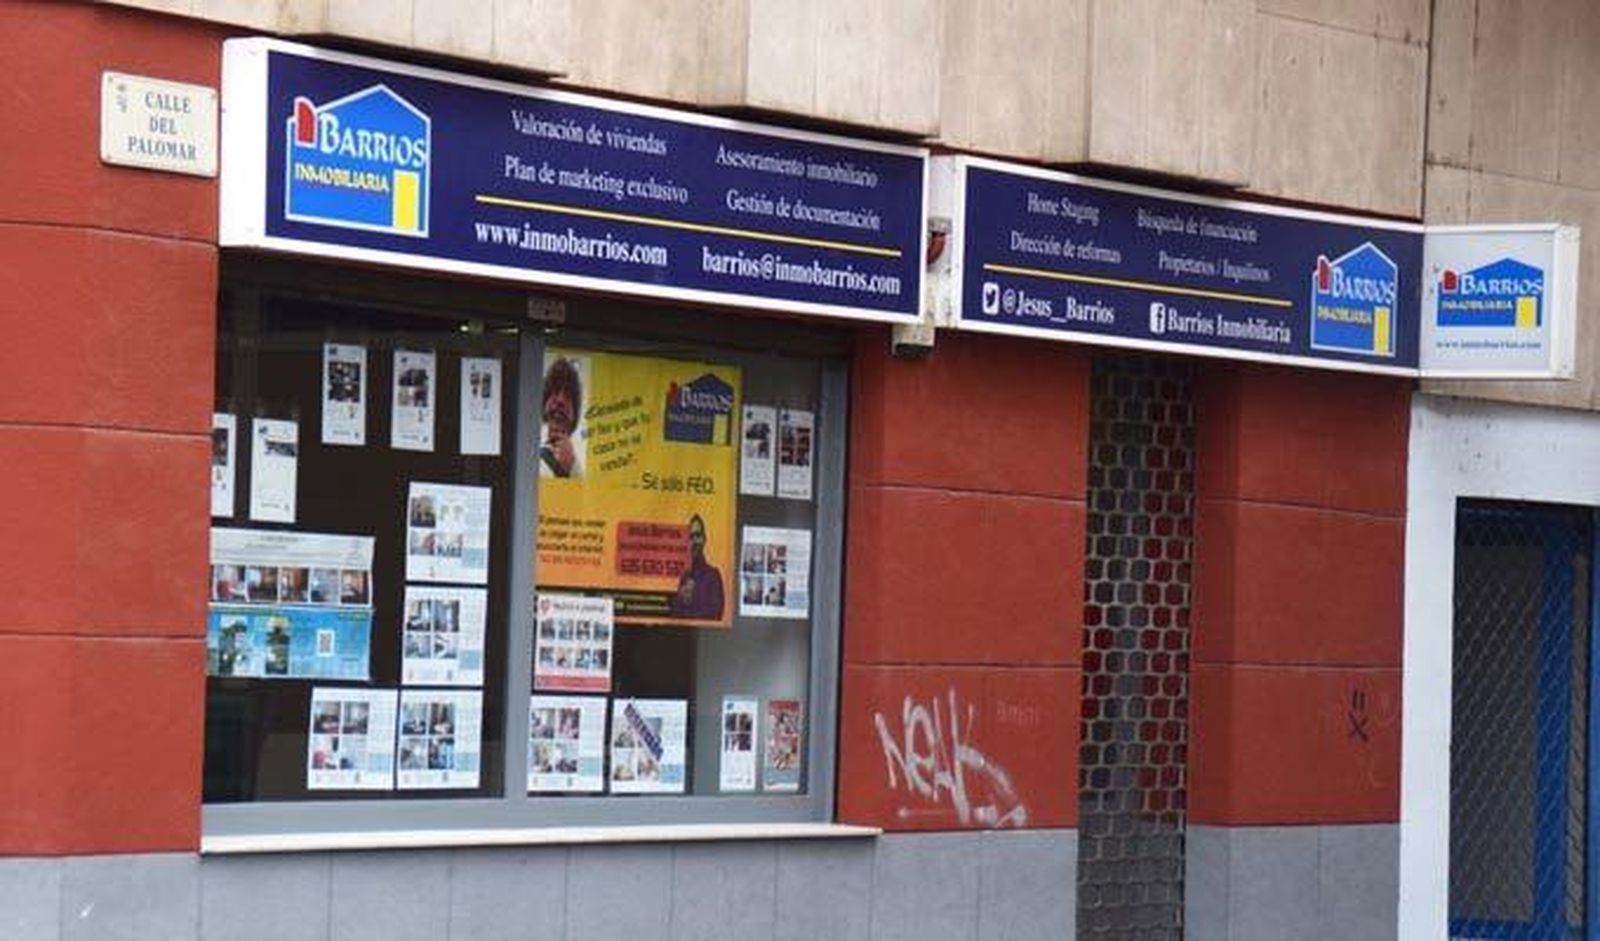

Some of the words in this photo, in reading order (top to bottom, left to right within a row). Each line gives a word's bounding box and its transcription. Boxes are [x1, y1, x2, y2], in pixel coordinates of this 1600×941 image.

[144, 91, 192, 115] CALLE
[149, 115, 178, 135] DEL
[319, 112, 427, 168] BARRIOS
[511, 108, 584, 143] Valoración
[585, 124, 603, 145] de
[605, 126, 668, 156] viviendas
[127, 136, 197, 161] PALOMAR
[715, 142, 805, 178] Asesoramiento
[806, 157, 879, 188] inmobiliario
[294, 165, 390, 193] INMOBILIARIA
[504, 154, 536, 182] Plan
[538, 161, 555, 184] de
[558, 167, 625, 201] marketing
[626, 177, 689, 204] exclusivo
[726, 188, 774, 215] Gestión
[775, 196, 791, 219] de
[792, 199, 881, 230] documentación
[1027, 192, 1059, 217] Home
[1061, 196, 1101, 228] Staging
[1137, 208, 1185, 236] Búsqueda
[1186, 214, 1199, 234] de
[1200, 217, 1258, 243] financiación
[474, 221, 668, 267] www.inmobarrios.com
[1010, 230, 1062, 256] Dirección
[1063, 237, 1077, 259] de
[1077, 241, 1122, 265] reformas
[702, 245, 901, 296] barrios@inmobarrios.com
[1158, 250, 1215, 278] Propietarios
[1222, 257, 1270, 284] Inquilinos
[1167, 307, 1215, 337] Barrios
[1216, 312, 1292, 345] Inmobiliaria
